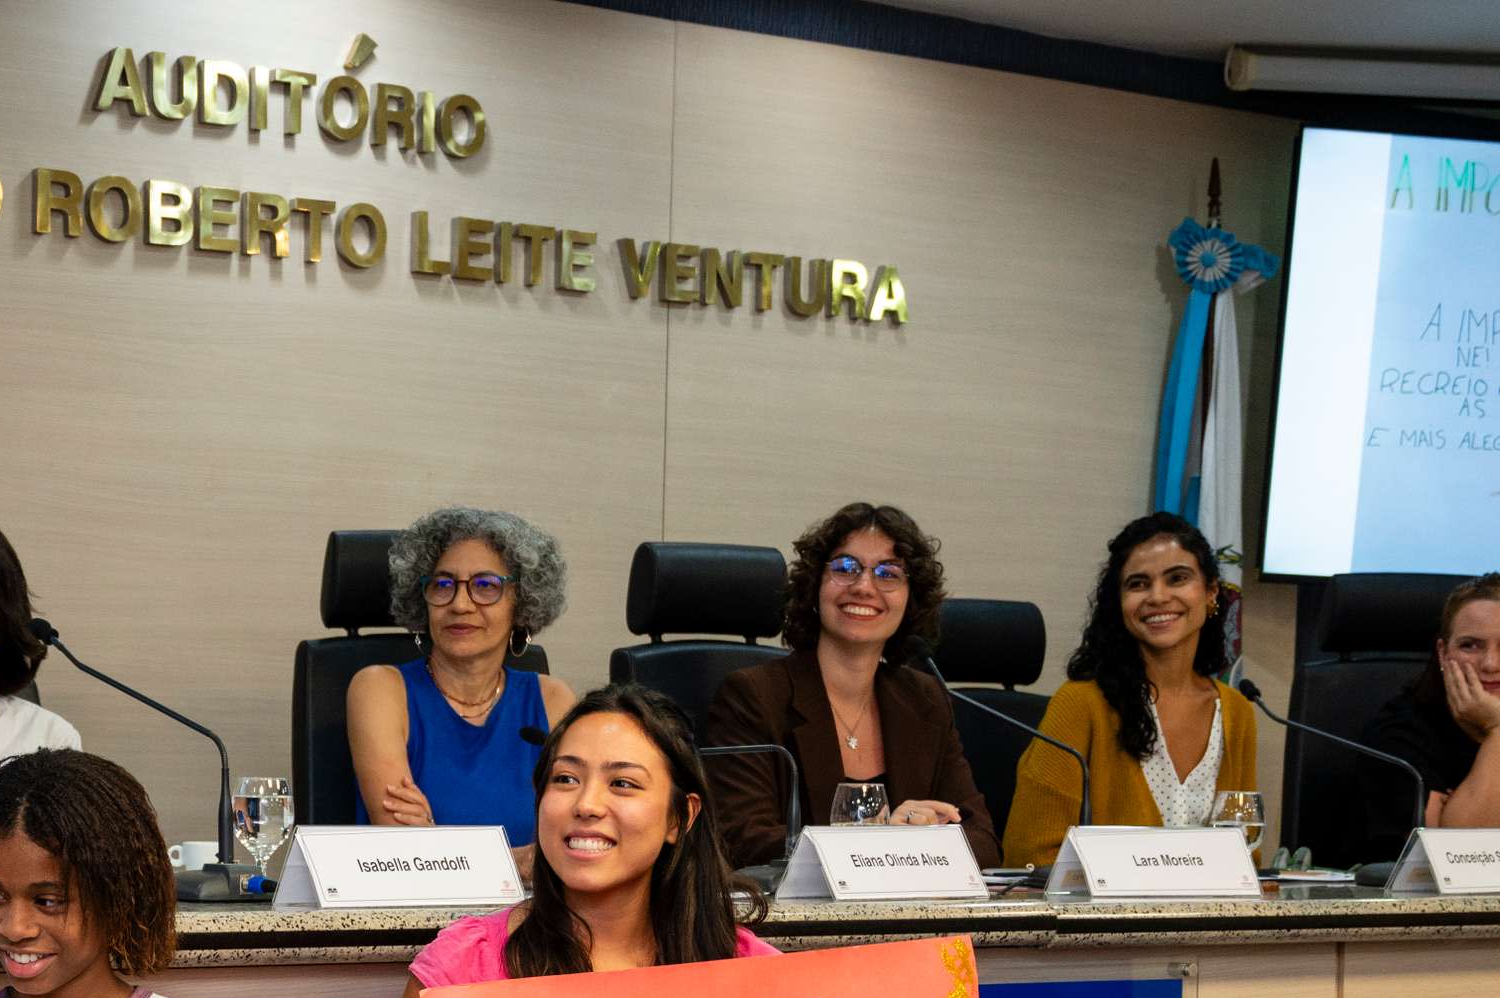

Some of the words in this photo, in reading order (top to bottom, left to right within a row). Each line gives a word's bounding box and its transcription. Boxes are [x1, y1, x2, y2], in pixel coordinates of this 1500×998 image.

[98, 33, 486, 158] AUDITÓRIO
[1390, 154, 1414, 210] A
[32, 168, 388, 269] ROBERTO
[411, 210, 597, 293] LEITE
[619, 238, 908, 324] VENTURA
[1420, 303, 1442, 341] A
[1380, 368, 1488, 396] RECREIO
[1458, 397, 1485, 418] AS
[1367, 427, 1390, 447] E
[1400, 429, 1446, 450] MAIS
[357, 858, 411, 873] Isabella
[413, 856, 470, 871] Gandolfi
[851, 854, 885, 868] Eliana
[885, 854, 919, 867] Olinda
[922, 854, 950, 867] Alves
[1132, 854, 1160, 867] Lara
[1160, 853, 1204, 867] Moreira
